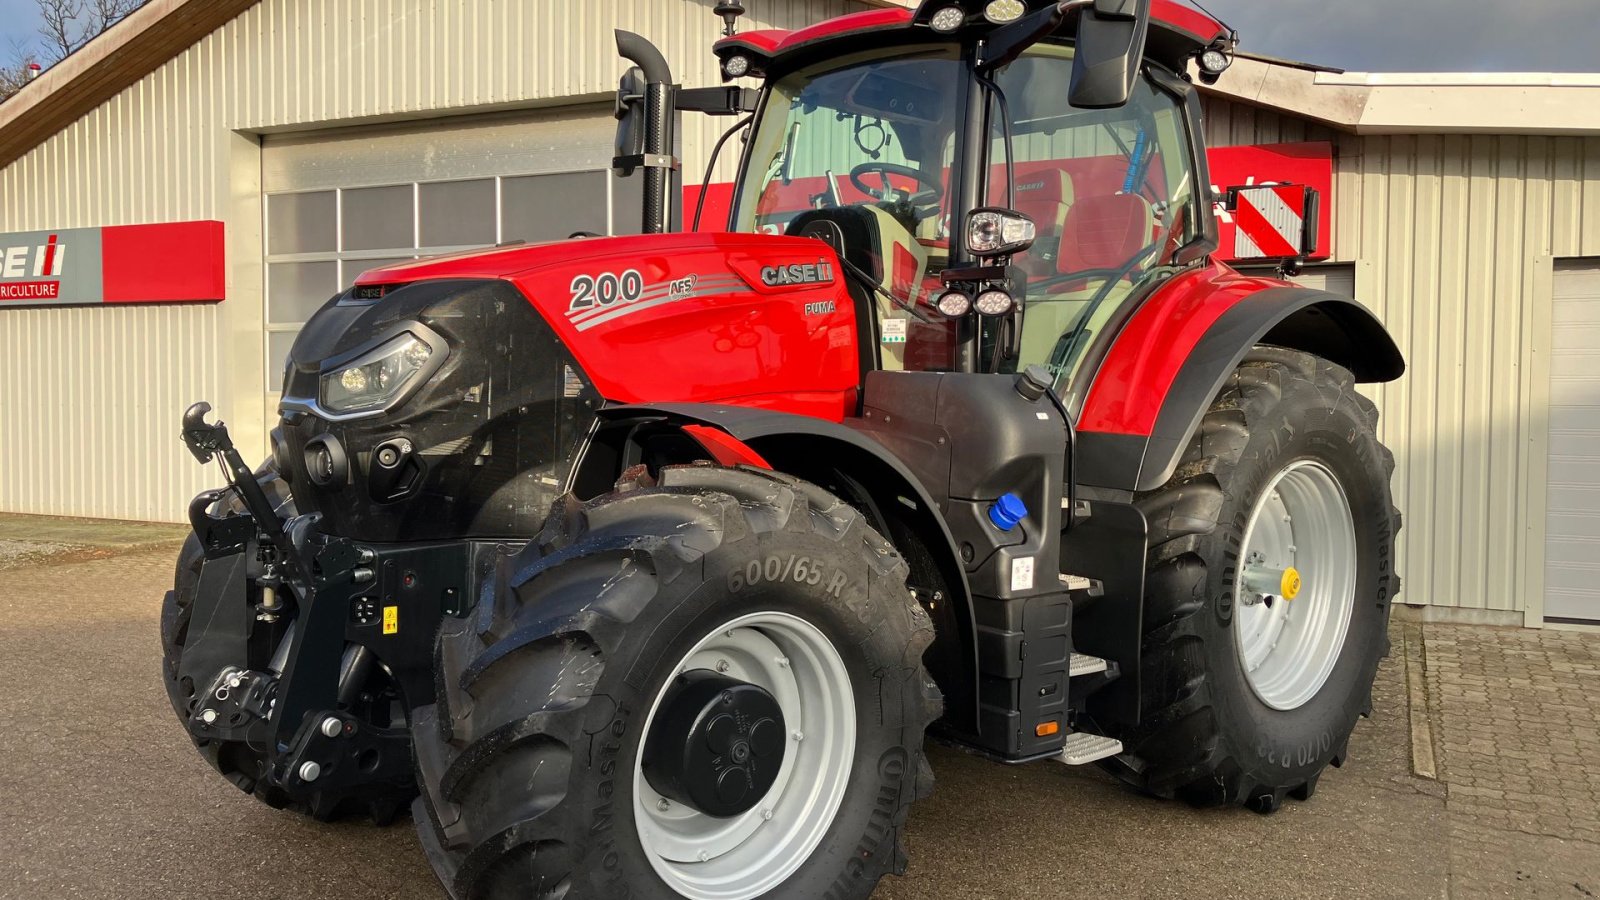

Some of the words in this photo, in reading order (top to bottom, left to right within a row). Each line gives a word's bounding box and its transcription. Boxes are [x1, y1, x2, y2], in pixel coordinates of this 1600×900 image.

[761, 263, 816, 285] CASE
[569, 268, 644, 311] 200
[669, 277, 693, 296] AFS
[804, 301, 837, 316] PUMA
[727, 554, 825, 594] 600/65
[826, 568, 849, 598] R
